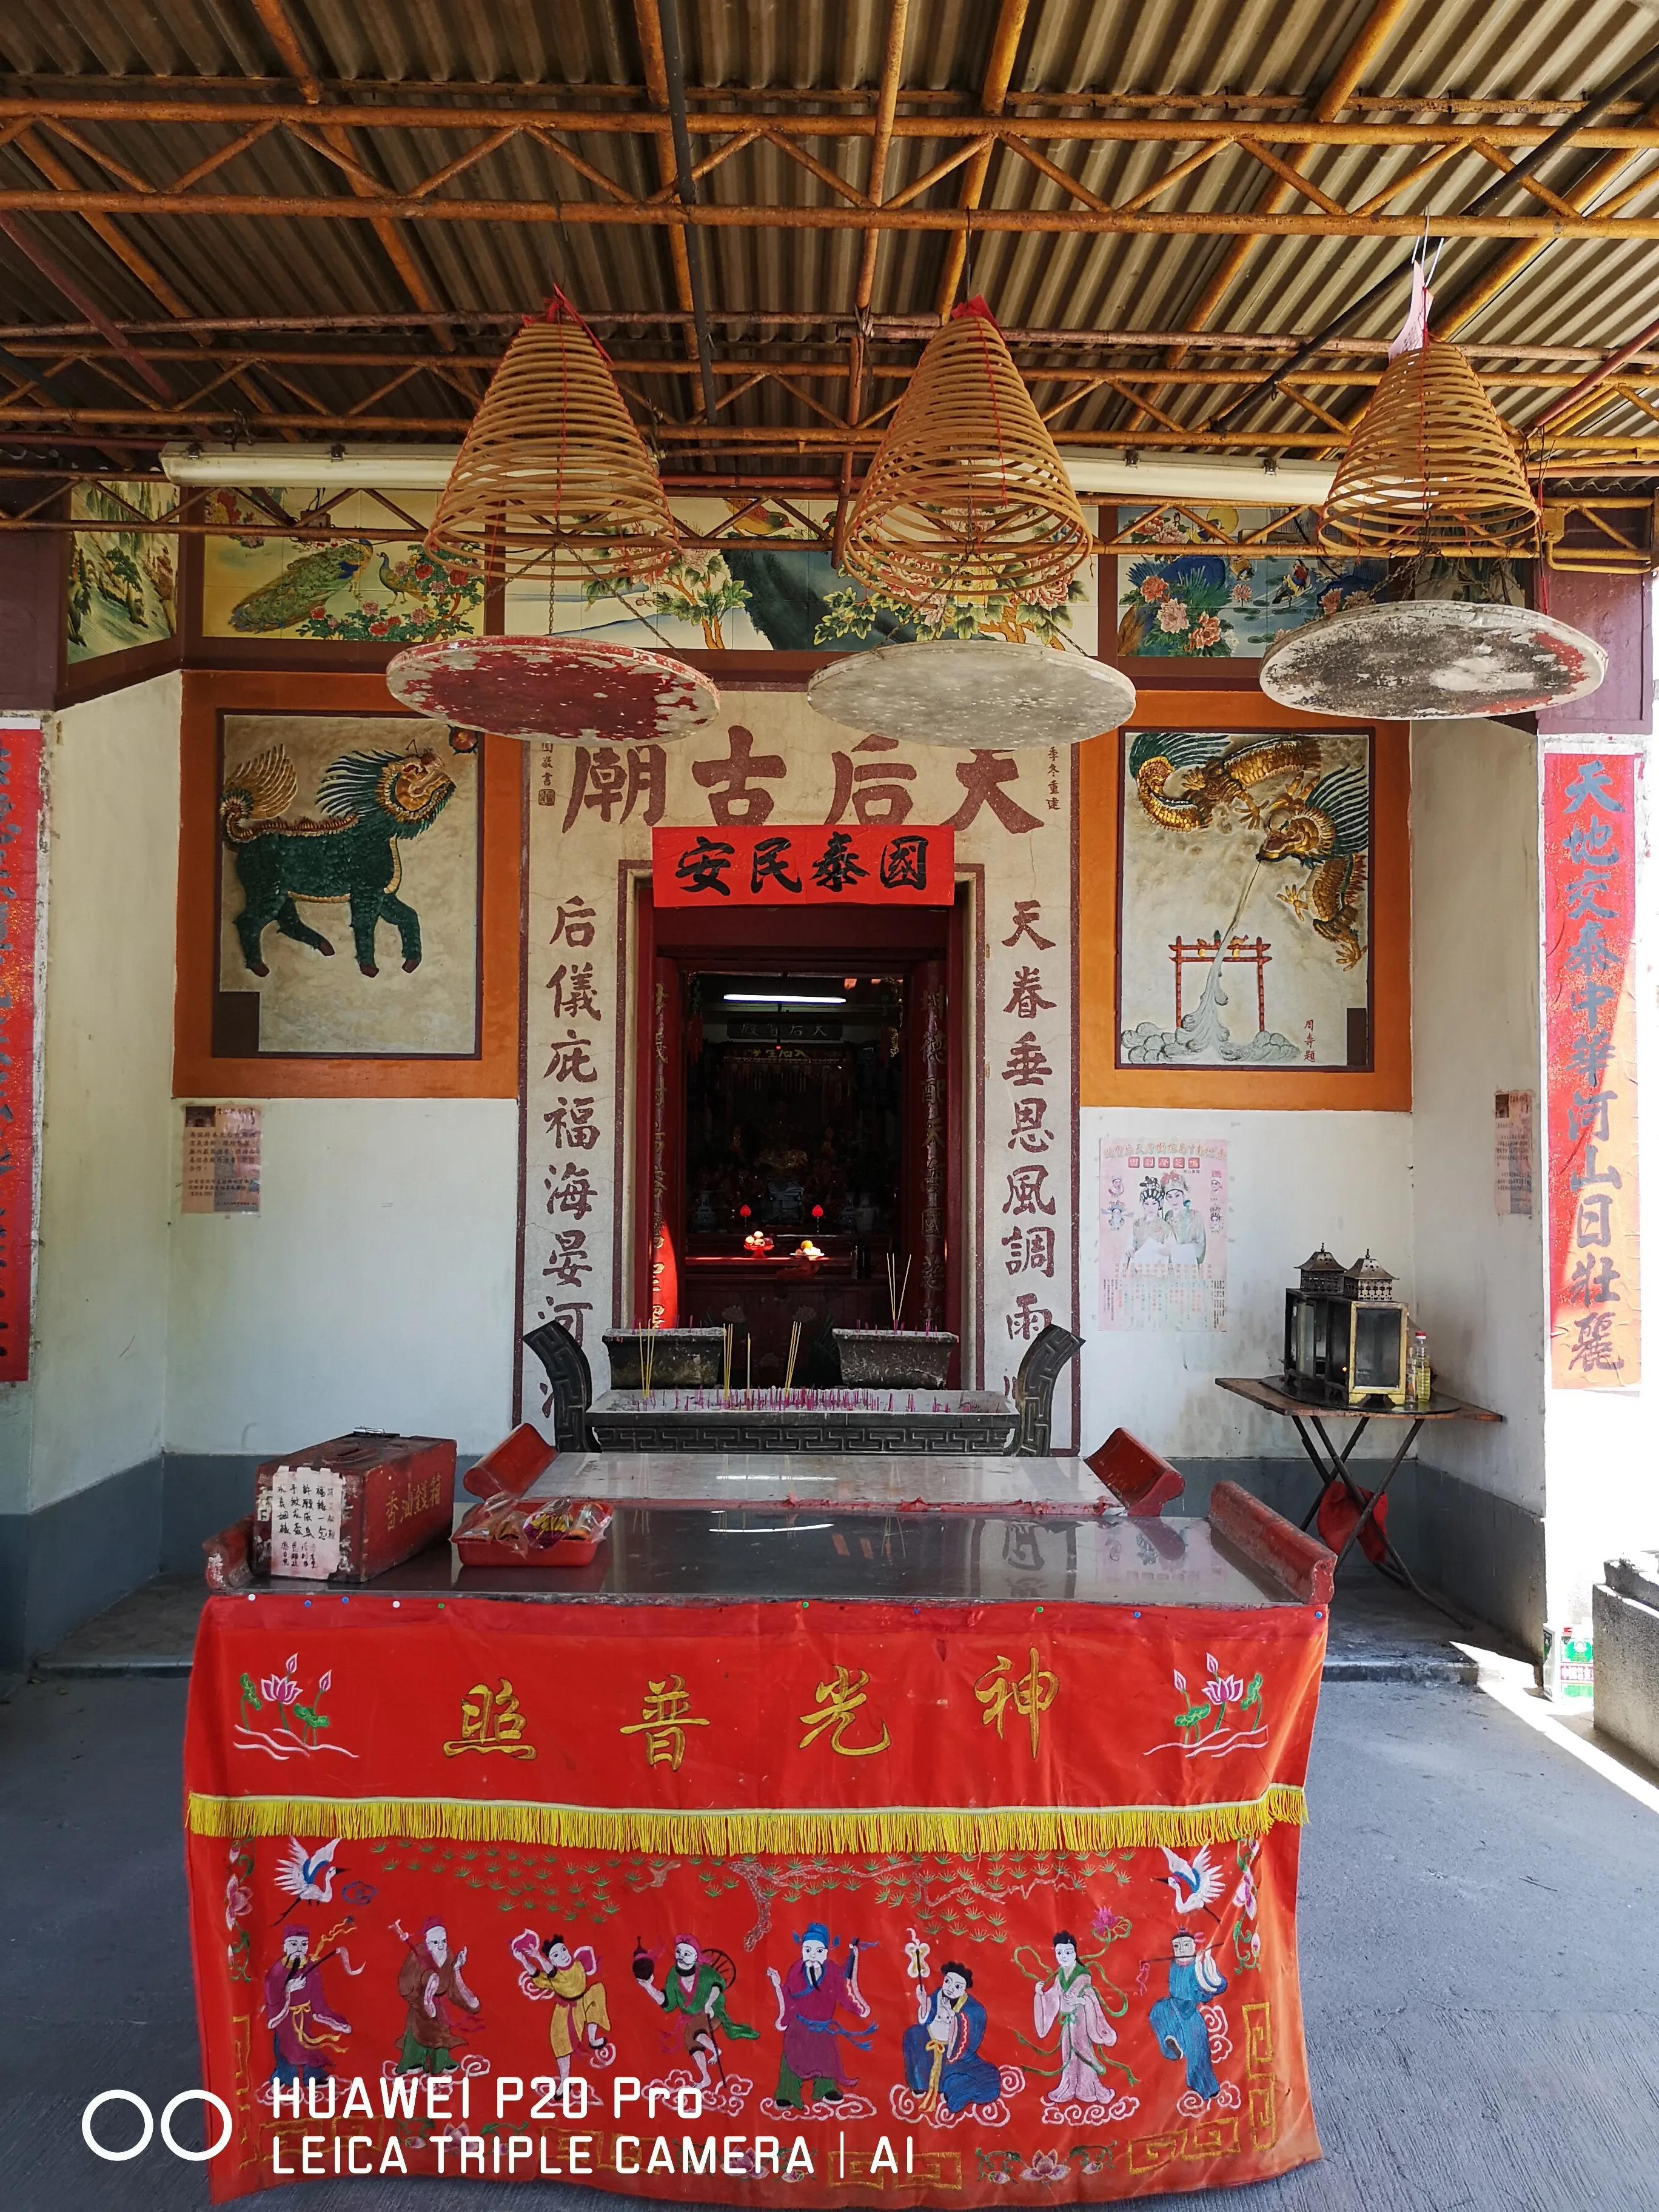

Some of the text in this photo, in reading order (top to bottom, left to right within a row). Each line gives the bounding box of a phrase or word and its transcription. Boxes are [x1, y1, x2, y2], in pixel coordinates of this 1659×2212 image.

[561, 725, 1044, 834] 天后古廟
[1046, 746, 1061, 810] 季冬重建
[675, 831, 928, 896] 國泰民安
[538, 895, 601, 1418] 后儀庇福海晏河
[1001, 900, 1057, 1398] 天眷垂恩風調雨
[443, 1646, 1061, 1771] 神光普照
